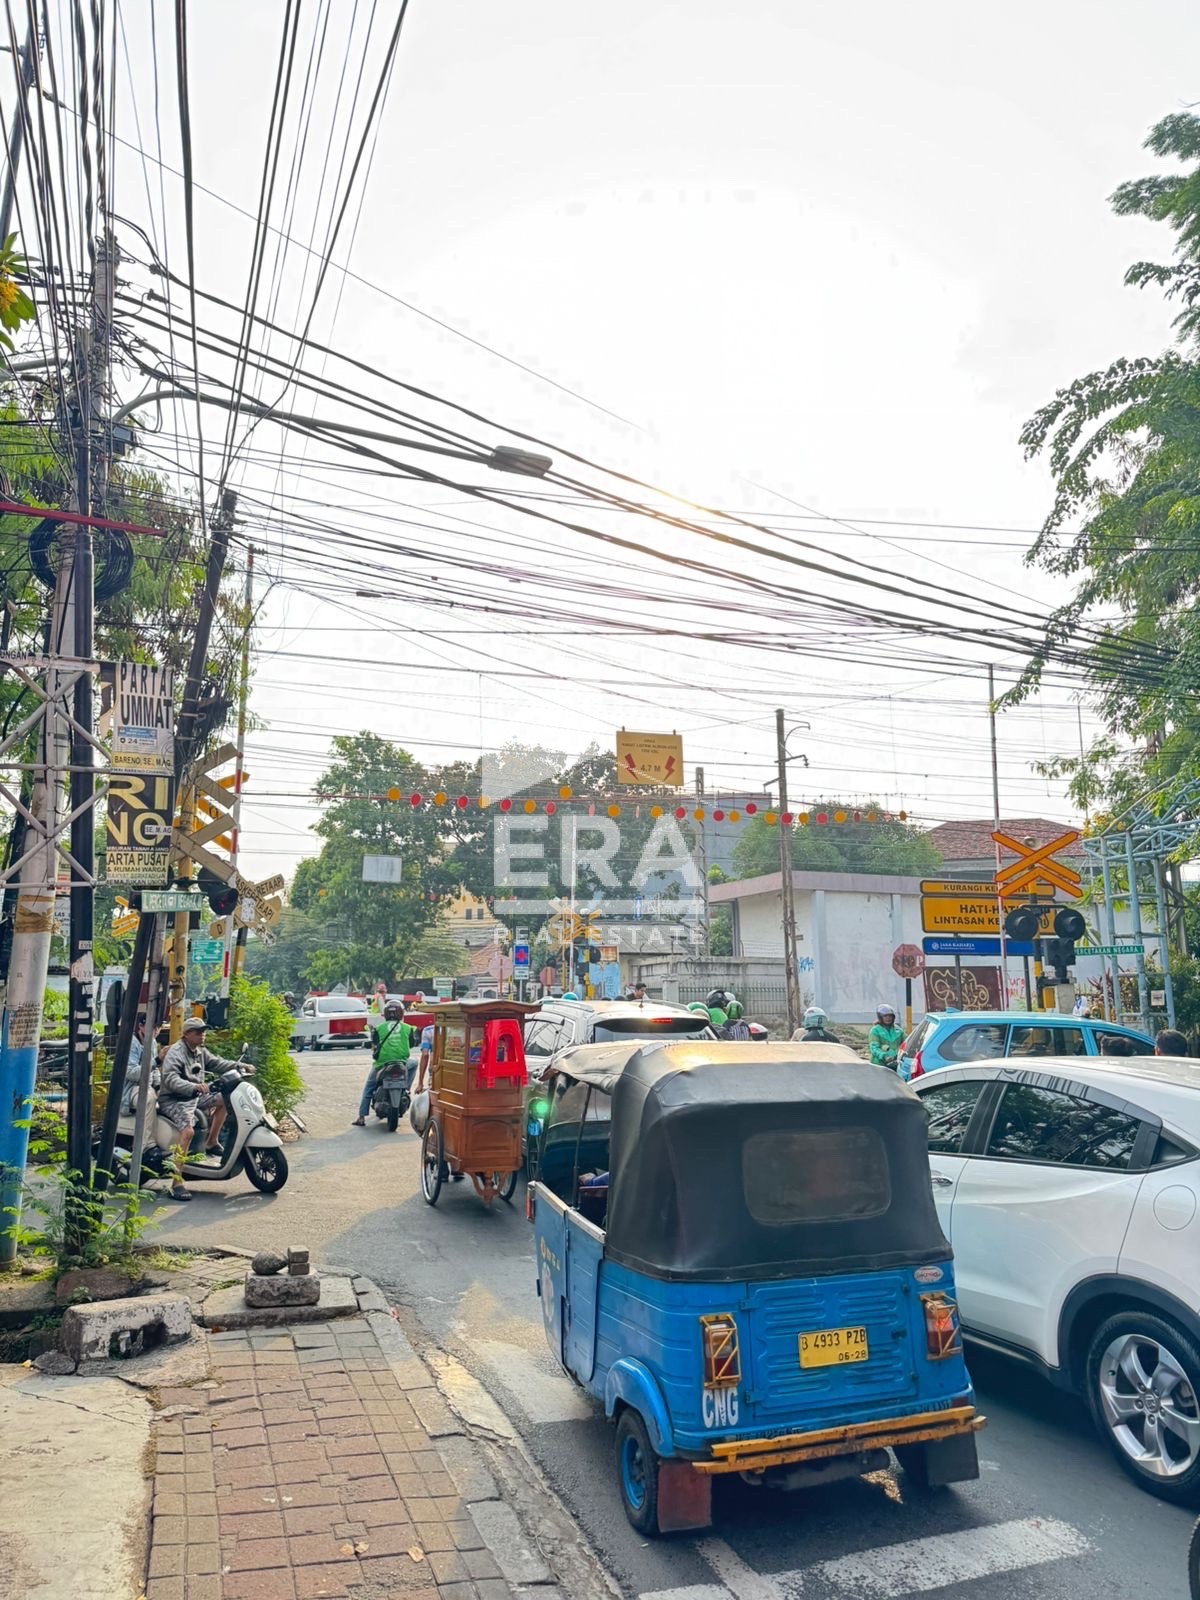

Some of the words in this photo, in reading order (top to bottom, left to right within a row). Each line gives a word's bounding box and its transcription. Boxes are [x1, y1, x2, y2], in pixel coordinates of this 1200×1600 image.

[120, 661, 174, 698] PARTAI
[120, 694, 173, 729] UMMAT
[138, 853, 168, 866] PUSAT
[943, 884, 983, 892] KURANGI
[934, 916, 985, 925] LINTASAN
[801, 1336, 809, 1351] B
[813, 1332, 840, 1349] 4933
[846, 1328, 866, 1345] PZB
[702, 1387, 739, 1429] CNG
